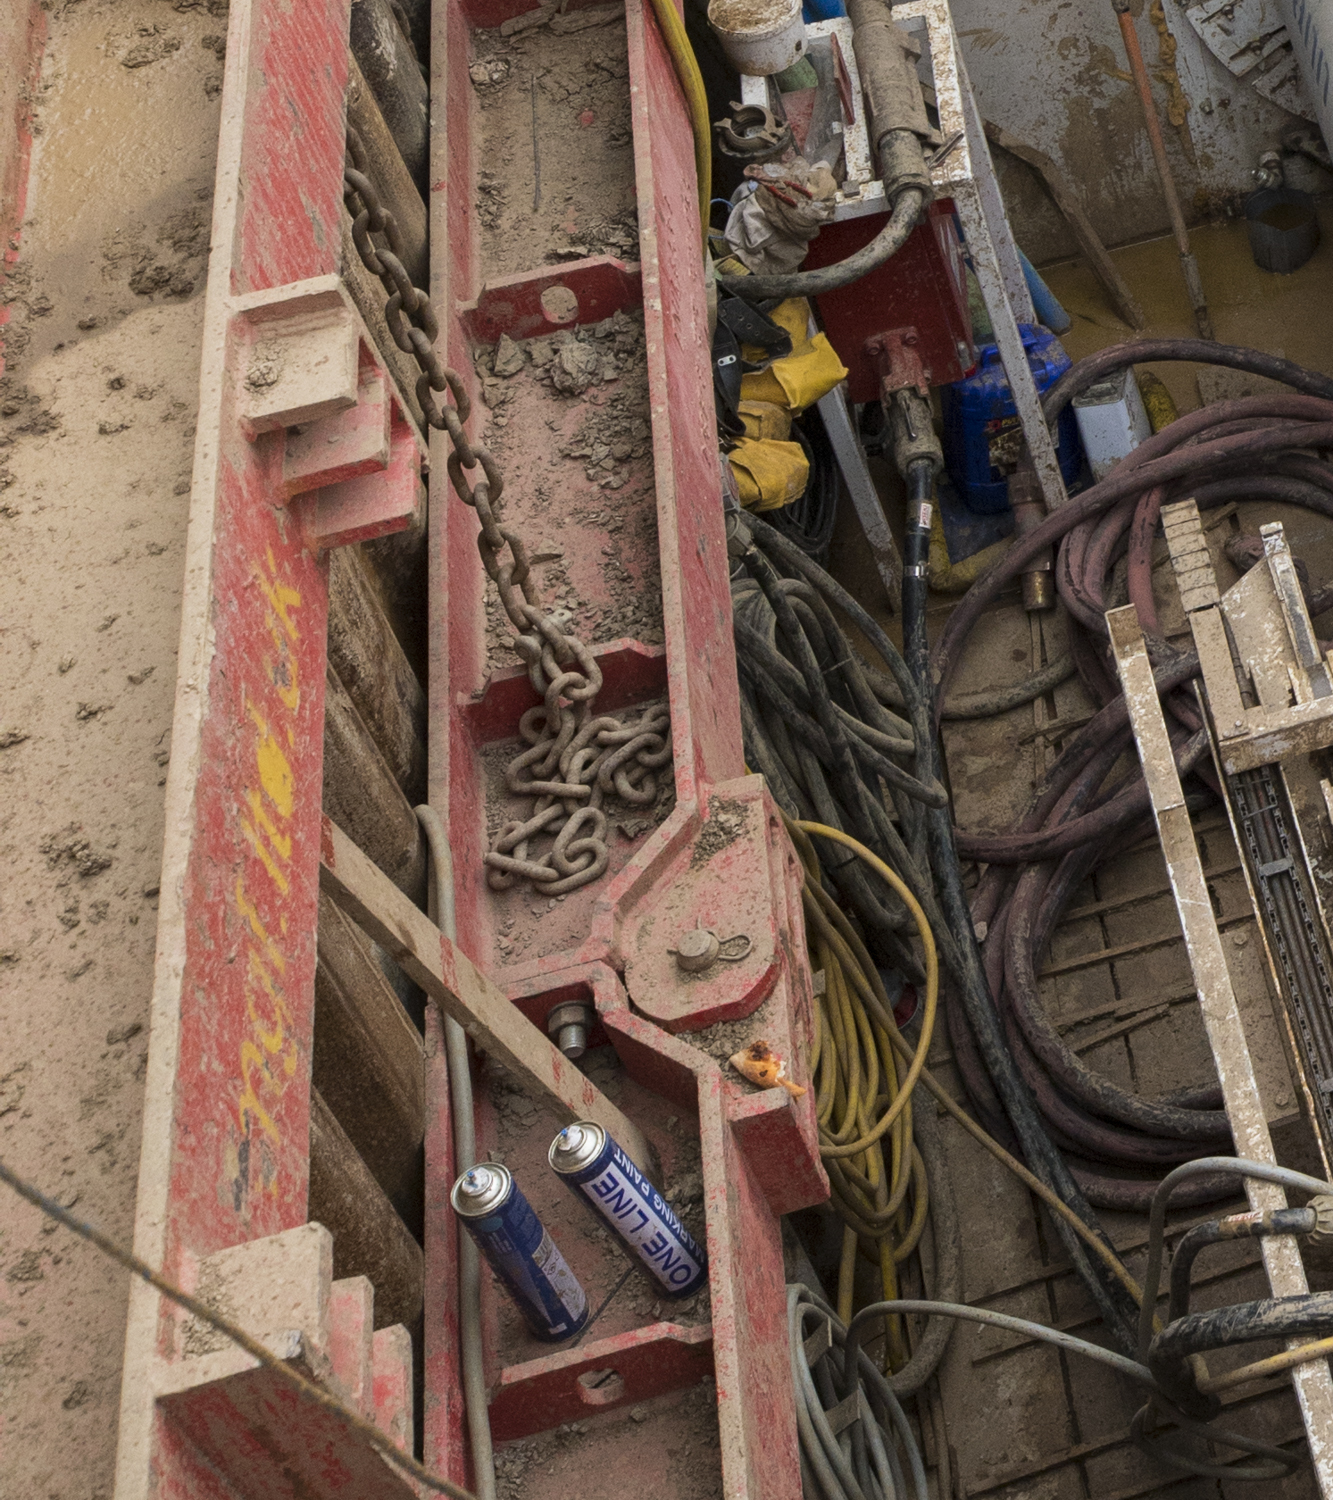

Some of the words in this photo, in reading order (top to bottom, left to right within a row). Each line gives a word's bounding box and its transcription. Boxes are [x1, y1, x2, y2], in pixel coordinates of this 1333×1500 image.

[613, 1146, 651, 1197] PAINT
[591, 1171, 650, 1234] LINE
[640, 1229, 692, 1286] ONE
